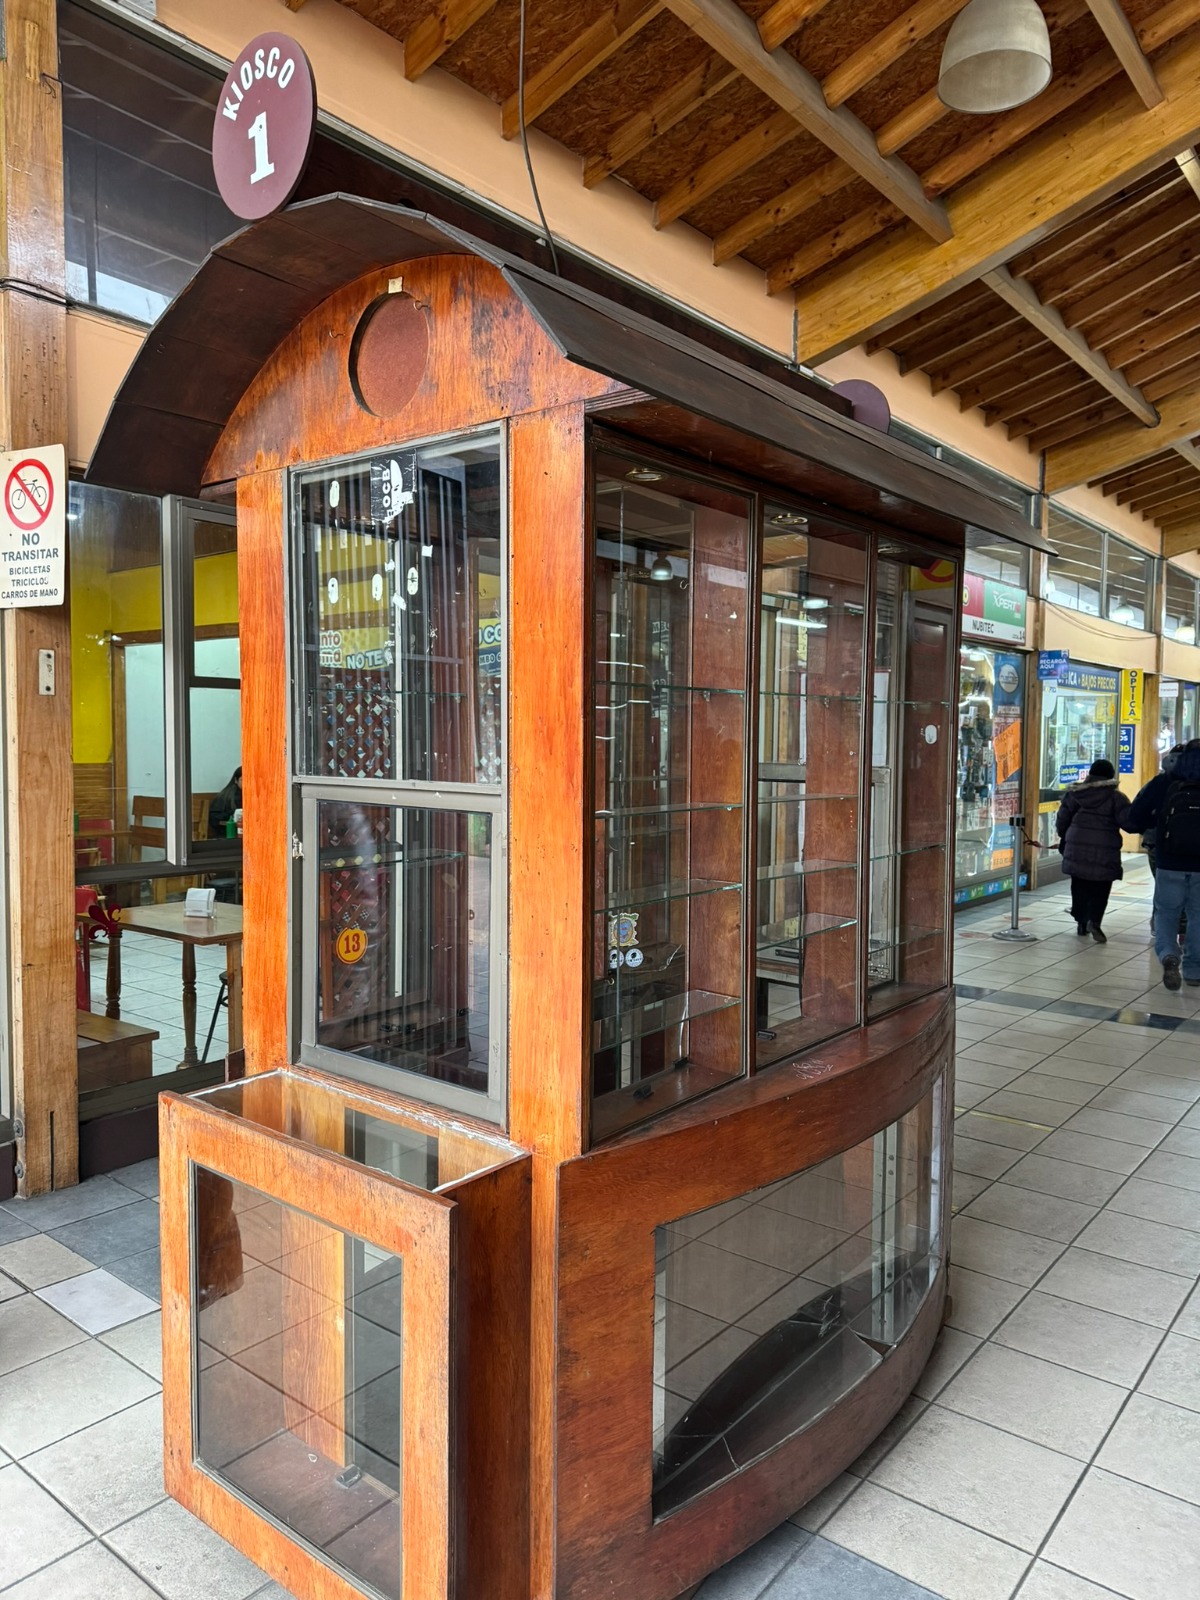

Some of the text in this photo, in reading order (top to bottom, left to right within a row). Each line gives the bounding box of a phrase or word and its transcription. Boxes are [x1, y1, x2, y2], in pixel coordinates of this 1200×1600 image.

[222, 46, 296, 121] KIOSCO
[247, 111, 275, 185] 1
[382, 468, 391, 508] OCB
[22, 532, 40, 546] NO
[2, 548, 59, 562] TRANSITAR
[9, 565, 51, 575] BICICLETAS
[11, 577, 49, 587] TRICICLOS
[1, 588, 59, 599] CARROS DE MANO
[1081, 673, 1097, 690] BAJOS
[1097, 676, 1116, 690] PRECIOS
[1128, 670, 1138, 716] OPTICA
[344, 933, 360, 954] 13
